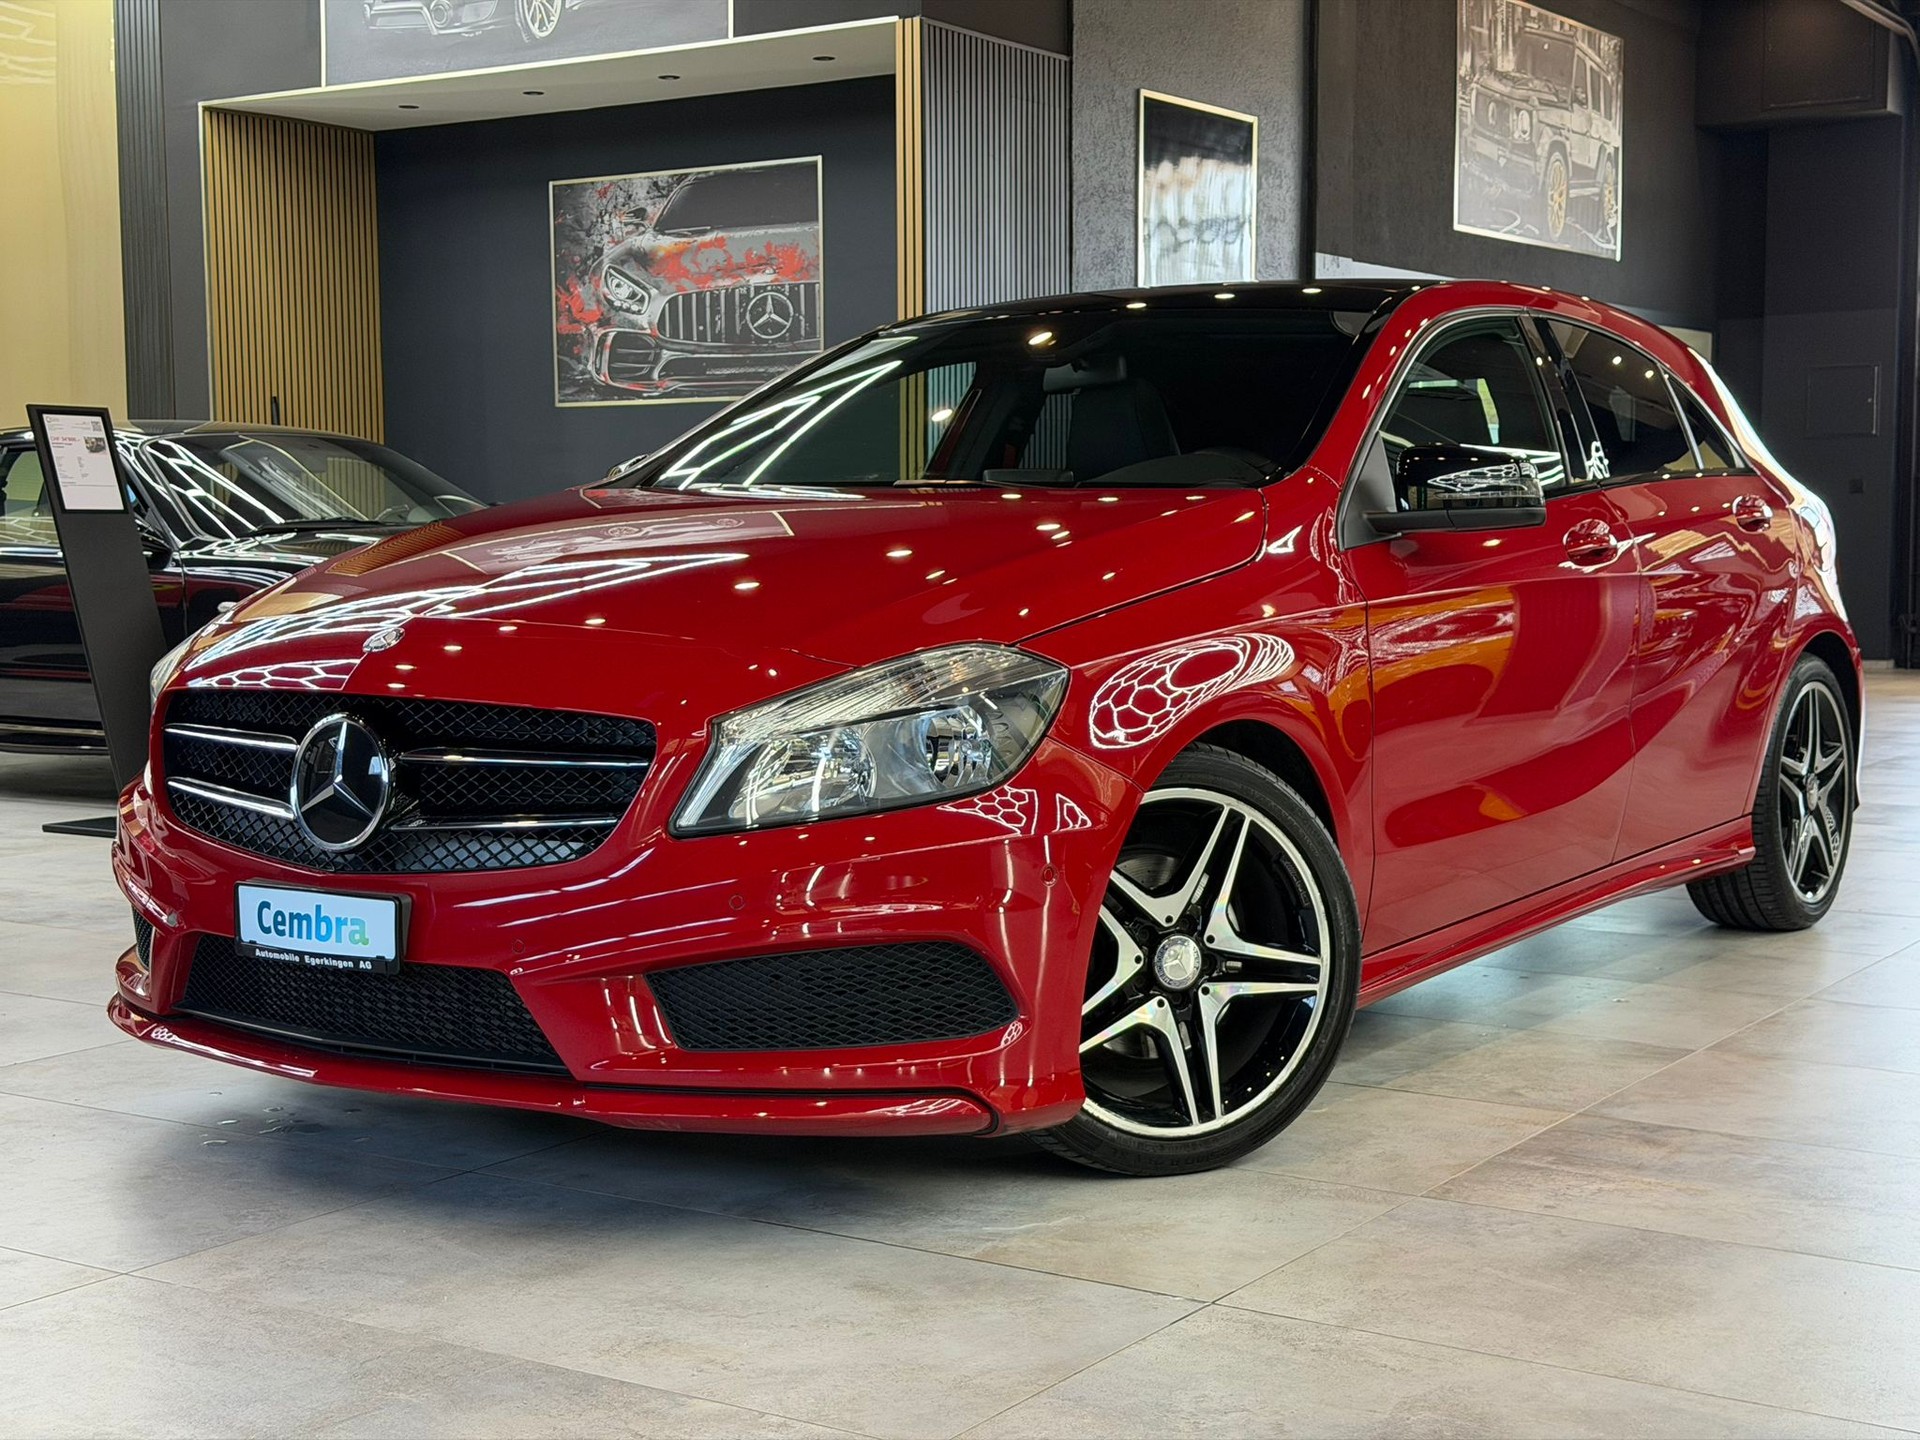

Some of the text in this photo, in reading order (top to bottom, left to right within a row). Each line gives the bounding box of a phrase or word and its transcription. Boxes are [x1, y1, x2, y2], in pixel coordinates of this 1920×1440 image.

[257, 900, 369, 946] Cembra
[256, 949, 372, 970] Automobile Egerkingen AG
